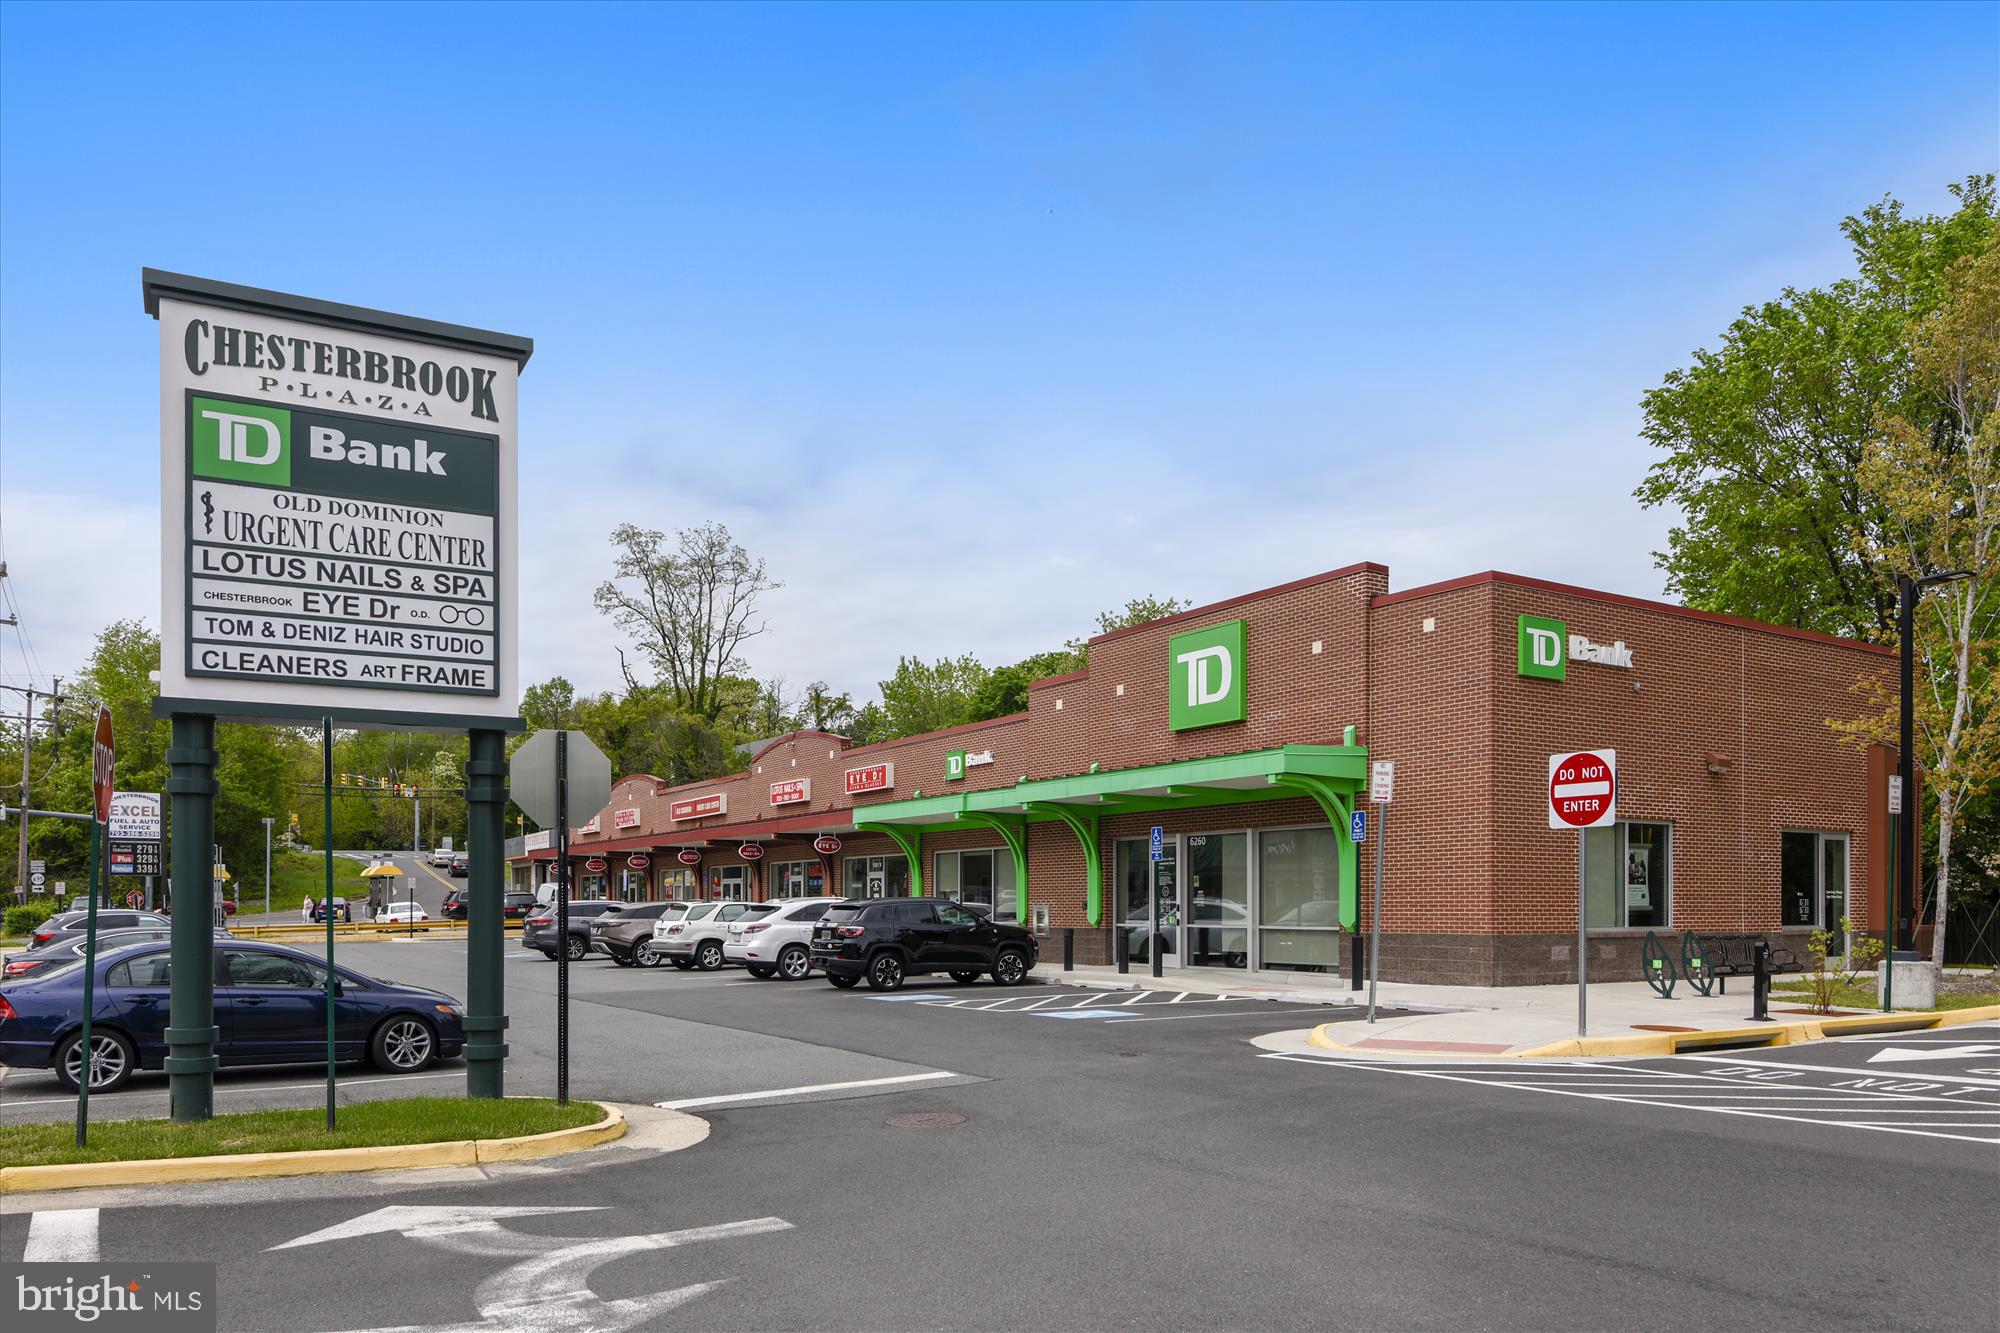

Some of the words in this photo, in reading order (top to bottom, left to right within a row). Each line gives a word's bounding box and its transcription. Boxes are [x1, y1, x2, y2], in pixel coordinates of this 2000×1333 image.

[184, 318, 500, 424] CHESTERBROOK
[202, 410, 281, 466] TD
[310, 425, 448, 476] Bank
[273, 494, 322, 515] OLD
[328, 501, 445, 528] DOMINION
[223, 510, 323, 552] URGENT
[328, 522, 391, 558] CARE
[397, 532, 487, 568] CENTER
[202, 549, 307, 580] LOTUS
[316, 562, 402, 590] NAILS
[411, 575, 426, 592] &
[433, 574, 487, 598] SPA
[203, 590, 294, 606] CHESTERBROOK
[302, 592, 361, 618] EYE
[369, 598, 401, 620] Dr
[410, 609, 430, 619] O.D.
[205, 617, 253, 638] TOM
[261, 621, 276, 640] &
[283, 622, 347, 644] DENIZ
[355, 628, 404, 649] HAIR
[410, 634, 485, 655] STUDIO
[1526, 627, 1561, 667] TD
[1568, 634, 1633, 668] Bank
[201, 650, 349, 678] CLEANERS
[360, 663, 397, 680] ART
[401, 664, 486, 688] FRAME
[1178, 646, 1232, 707] TD
[95, 742, 113, 788] STOP
[947, 756, 961, 774] TD
[965, 750, 994, 767] Bank
[1560, 768, 1575, 780] DO
[1582, 766, 1604, 778] NOT
[850, 772, 867, 784] EYE
[112, 793, 160, 804] HESTERBROOK
[1563, 800, 1600, 813] ENTER
[111, 805, 159, 817] EXCEL
[137, 844, 153, 854] 279
[1189, 836, 1206, 846] 6260
[117, 854, 132, 863] Plus
[137, 854, 153, 864] 329
[137, 864, 153, 874] 339
[1701, 1066, 1806, 1080] DO
[1830, 1078, 2000, 1096] NOT
